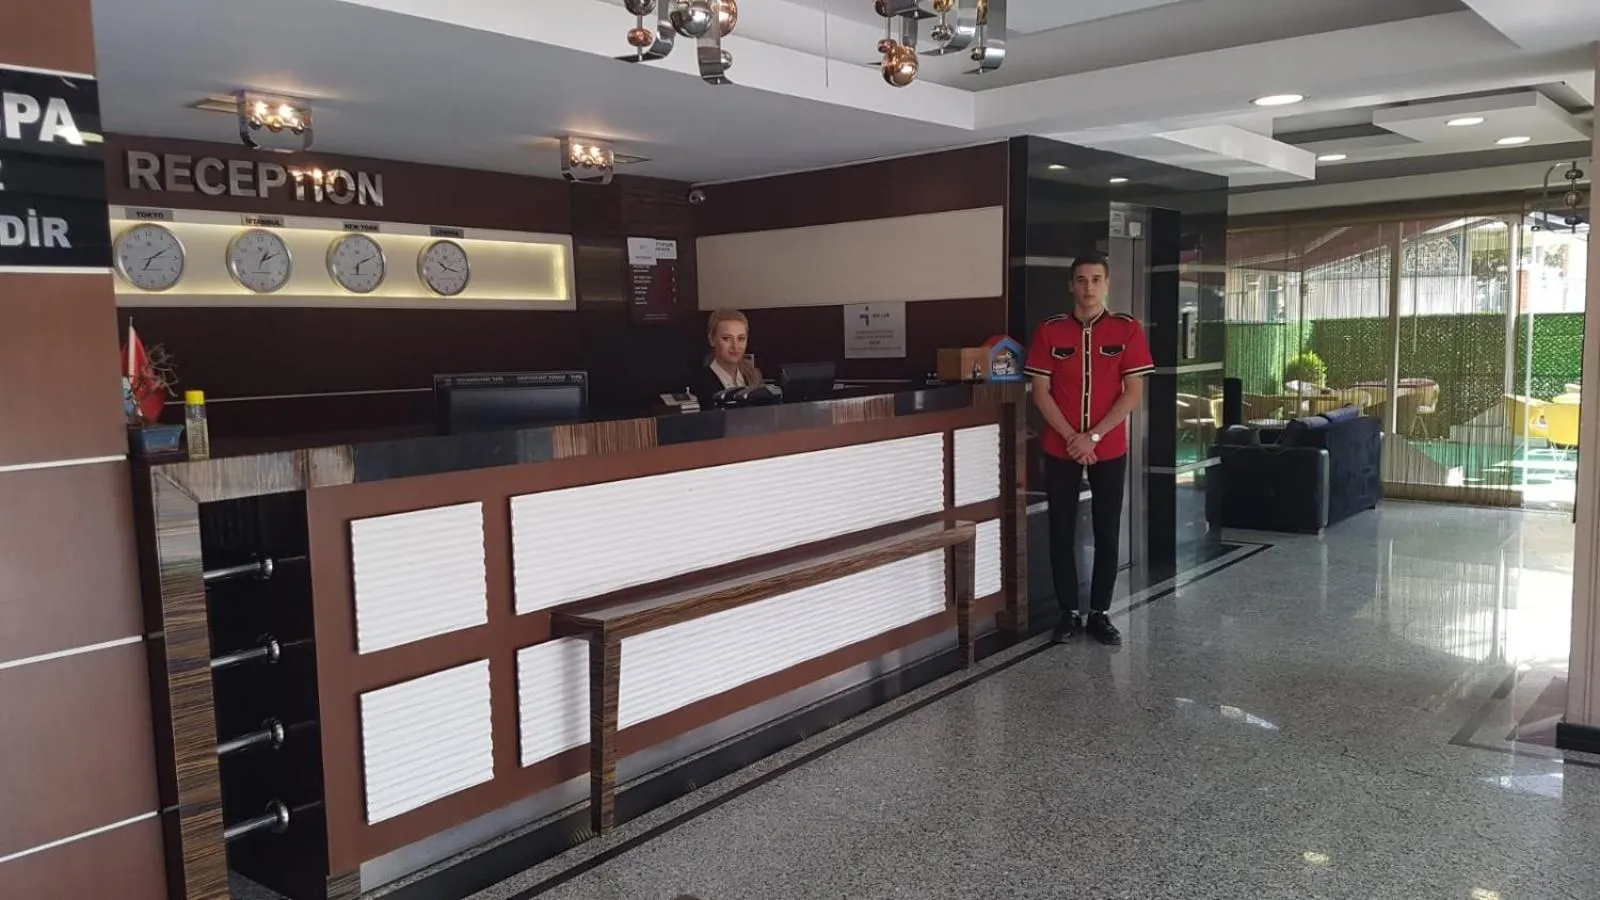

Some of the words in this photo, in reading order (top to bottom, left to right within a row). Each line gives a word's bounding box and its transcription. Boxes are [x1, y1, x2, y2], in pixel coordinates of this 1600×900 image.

[0, 91, 86, 146] PA
[127, 151, 384, 207] RECEPTION
[136, 211, 164, 219] TOKYO
[360, 223, 378, 231] YORK
